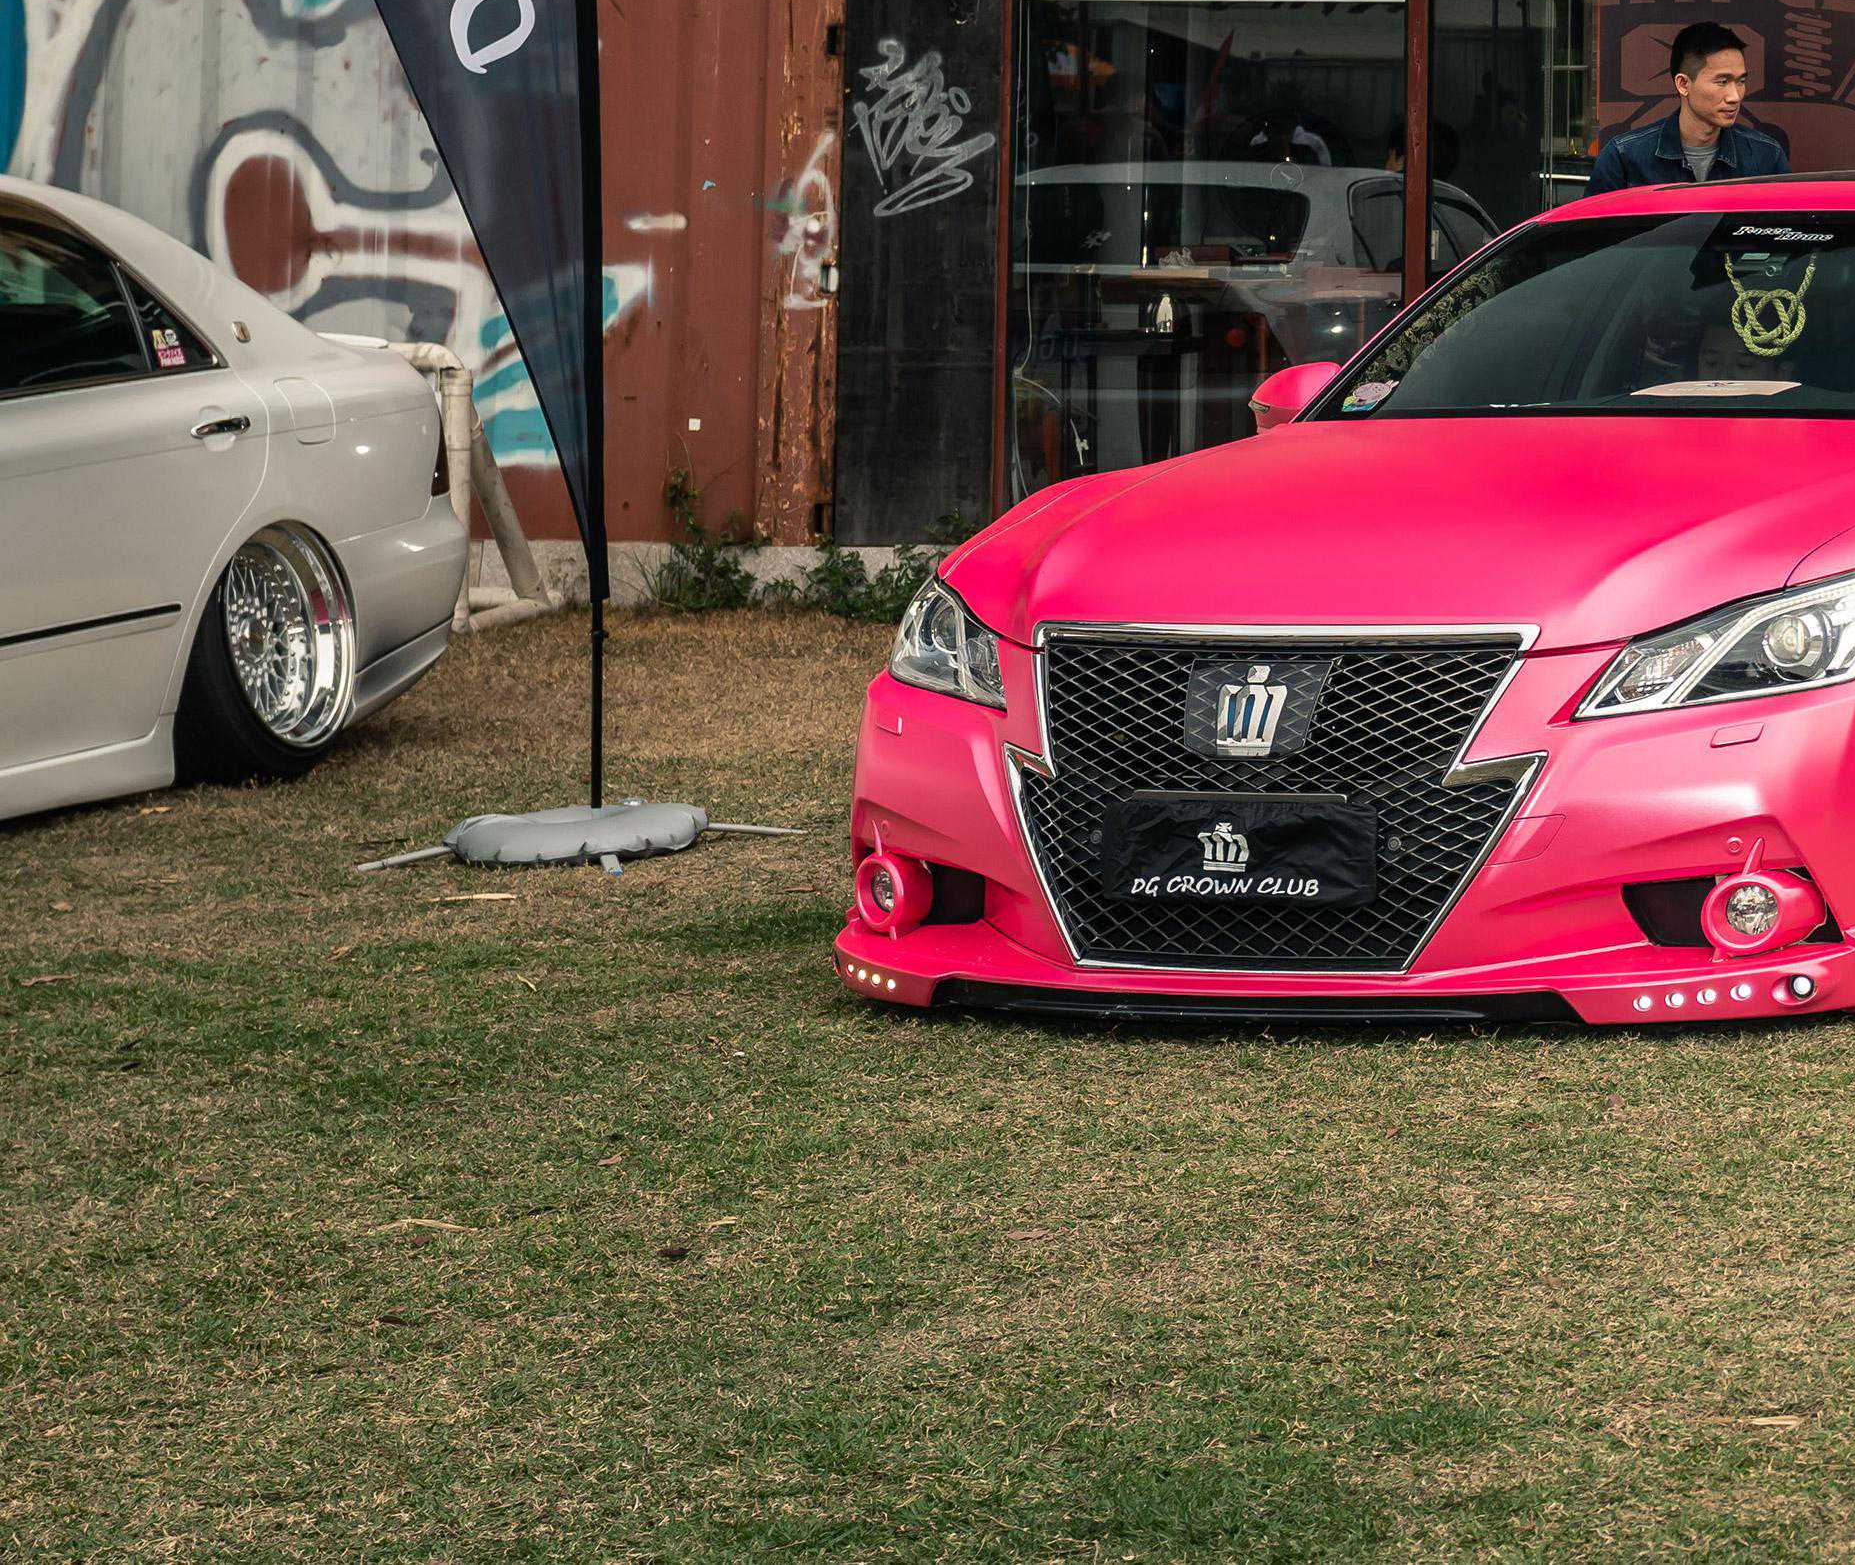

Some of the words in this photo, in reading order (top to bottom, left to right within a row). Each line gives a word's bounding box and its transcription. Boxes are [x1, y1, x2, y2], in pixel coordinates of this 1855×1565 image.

[1130, 875, 1161, 898] DG
[1166, 875, 1254, 896] CROWN
[1256, 876, 1320, 898] CLUB
